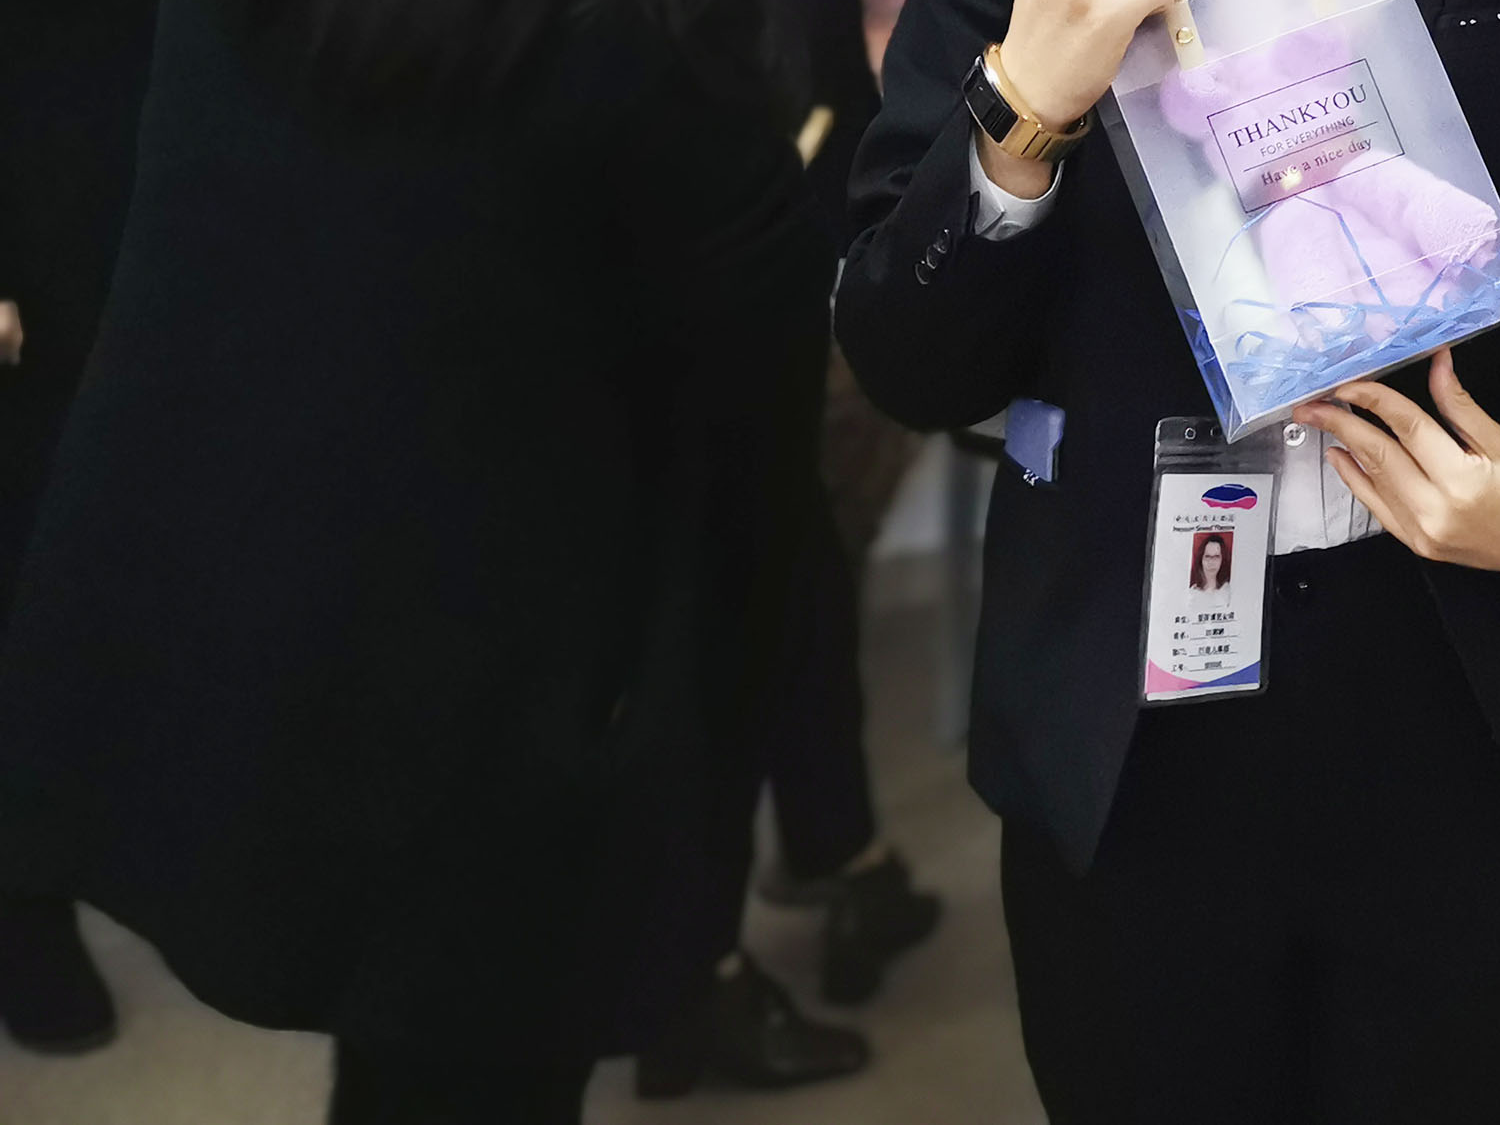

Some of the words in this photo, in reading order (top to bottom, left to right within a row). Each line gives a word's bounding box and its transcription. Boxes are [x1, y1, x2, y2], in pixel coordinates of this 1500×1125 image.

[1227, 83, 1368, 148] THANKYOU
[1259, 140, 1285, 158] FOR
[1287, 115, 1355, 149] EVERYTHING
[1261, 163, 1300, 186] Have
[1301, 161, 1312, 172] a
[1314, 148, 1344, 167] nice
[1348, 137, 1373, 154] day
